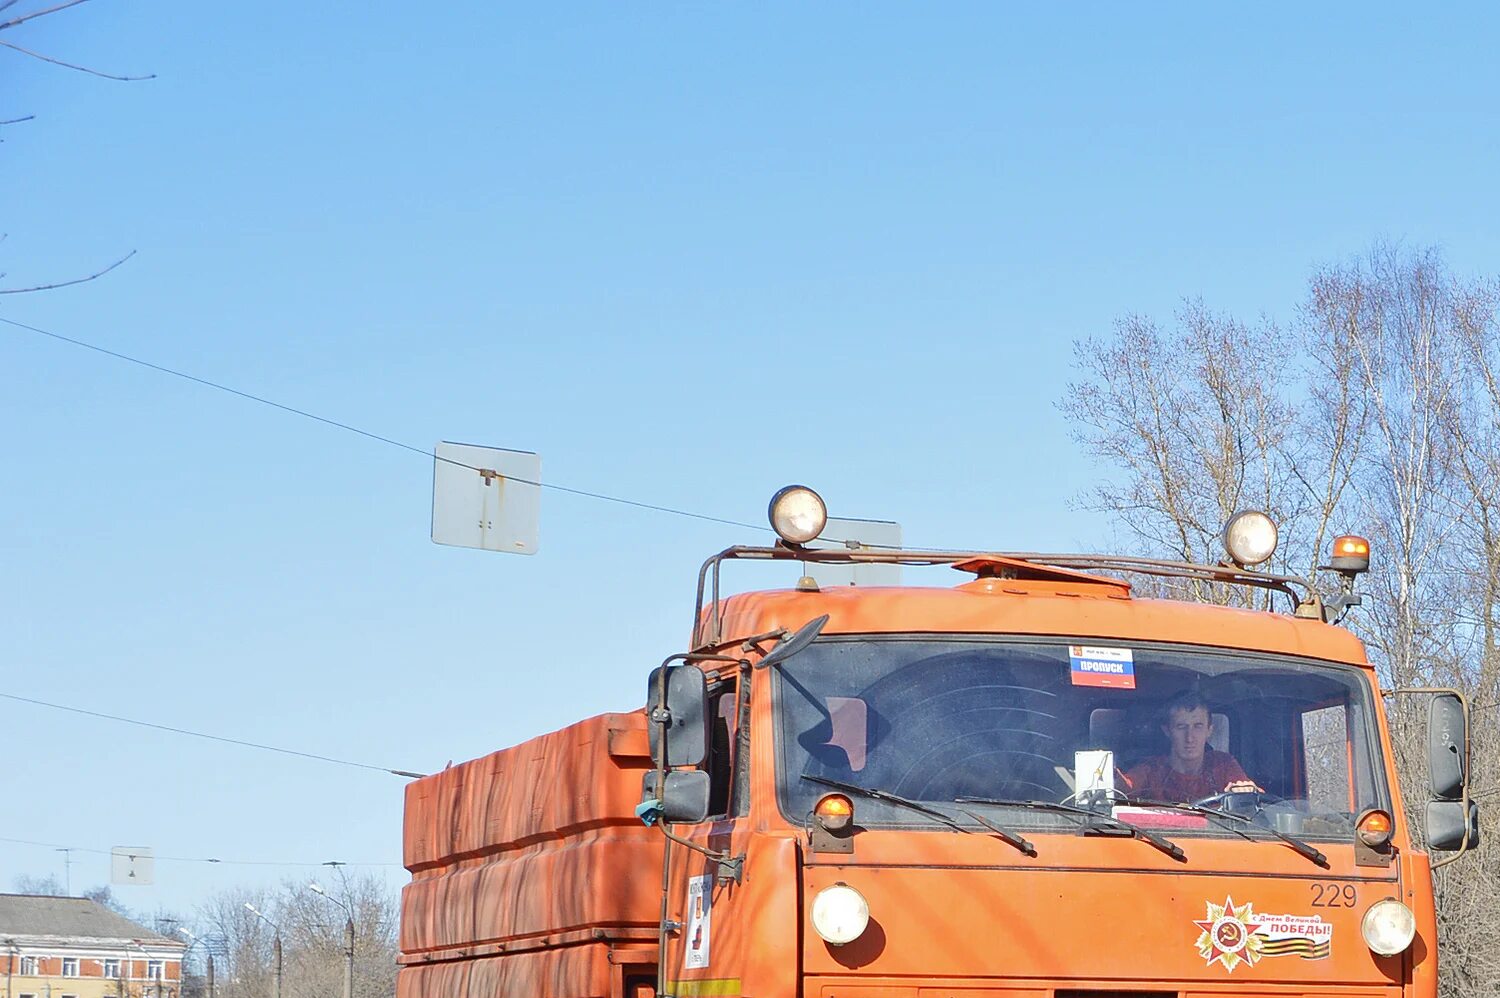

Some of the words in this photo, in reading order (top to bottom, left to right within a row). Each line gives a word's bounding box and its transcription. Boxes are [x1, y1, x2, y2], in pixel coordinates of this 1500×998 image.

[1080, 660, 1124, 674] ПРОПУСК
[1310, 883, 1357, 909] 229
[1285, 916, 1320, 924] Великой
[1270, 923, 1331, 937] ПОБЕДЫ!
